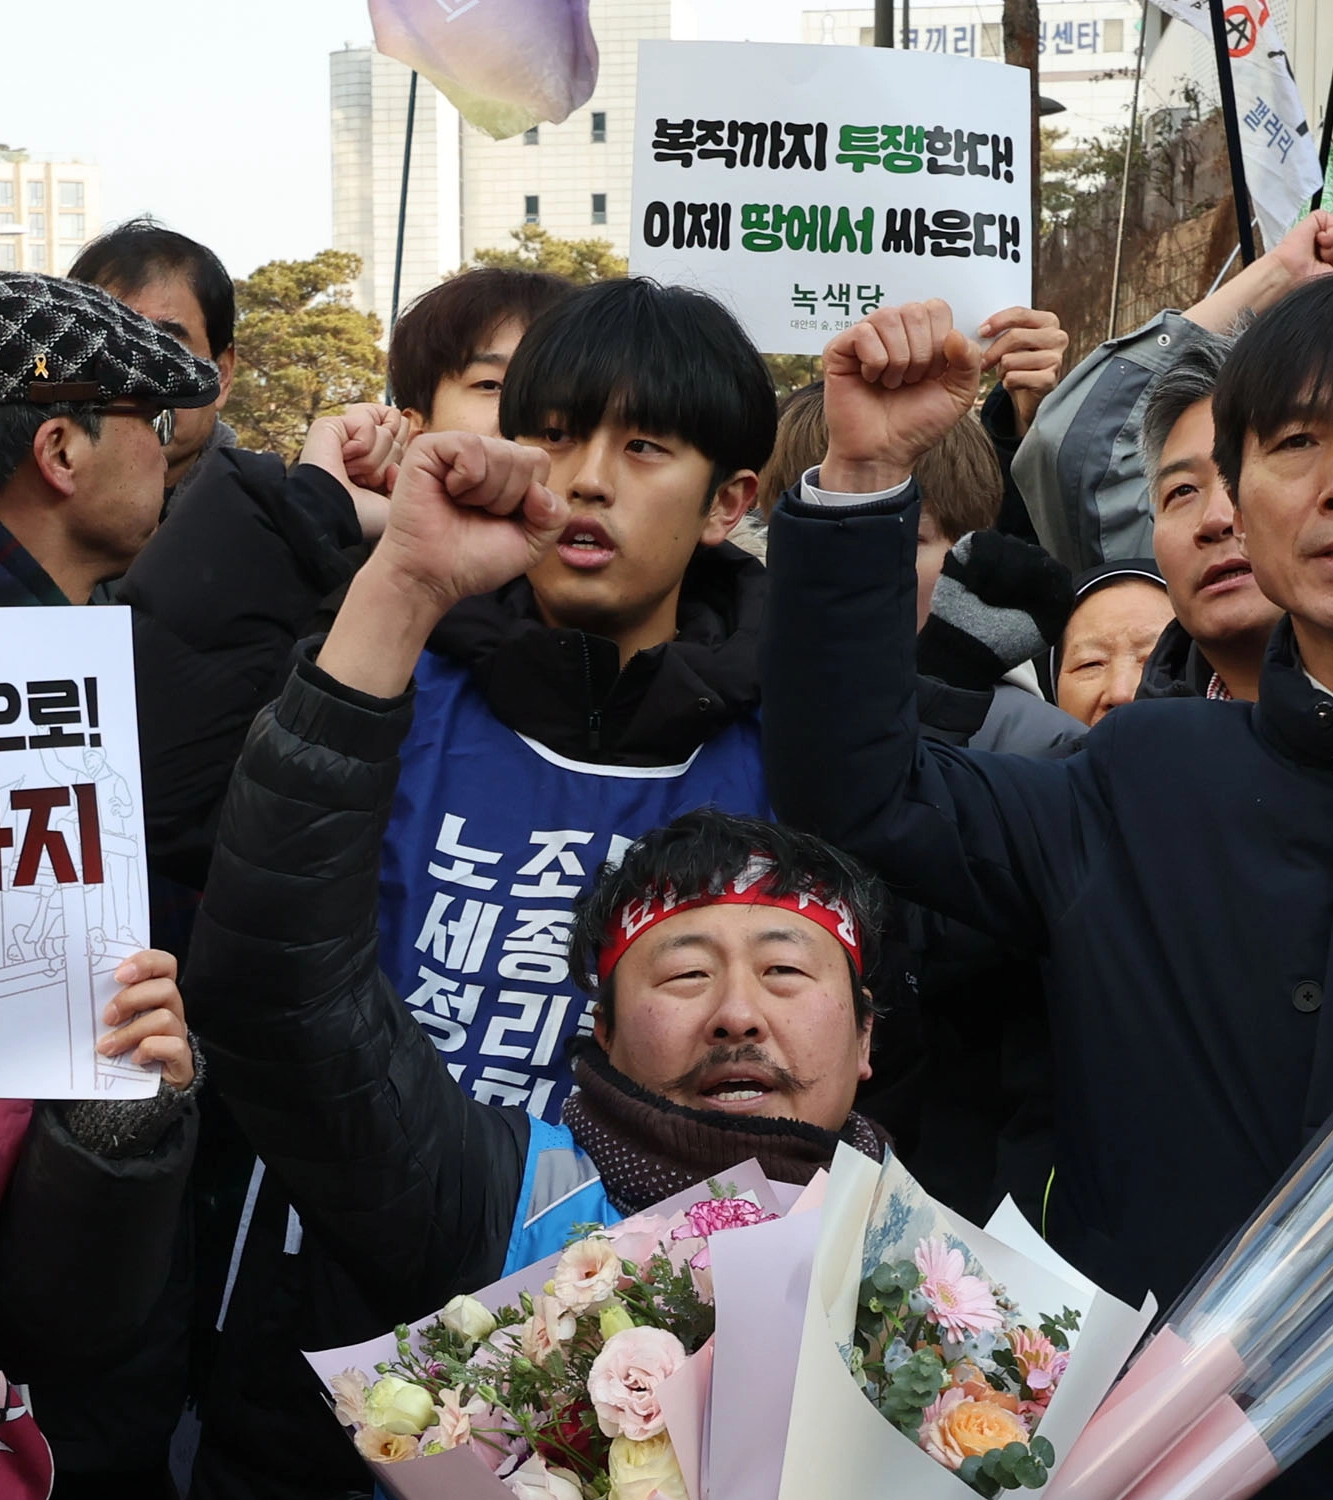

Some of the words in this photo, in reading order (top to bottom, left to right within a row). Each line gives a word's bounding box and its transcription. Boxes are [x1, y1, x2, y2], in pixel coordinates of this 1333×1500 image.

[651, 119, 827, 171] 복직까지
[836, 123, 1014, 183] 투쟁한다!
[1243, 96, 1294, 164] 갤러리
[643, 201, 731, 250] 이제
[740, 205, 874, 255] 땅에서
[882, 209, 1020, 263] 싸운다!
[791, 283, 884, 316] 녹색당
[427, 812, 635, 899] 노조
[414, 891, 598, 987] 세종
[404, 965, 595, 1067] 정리
